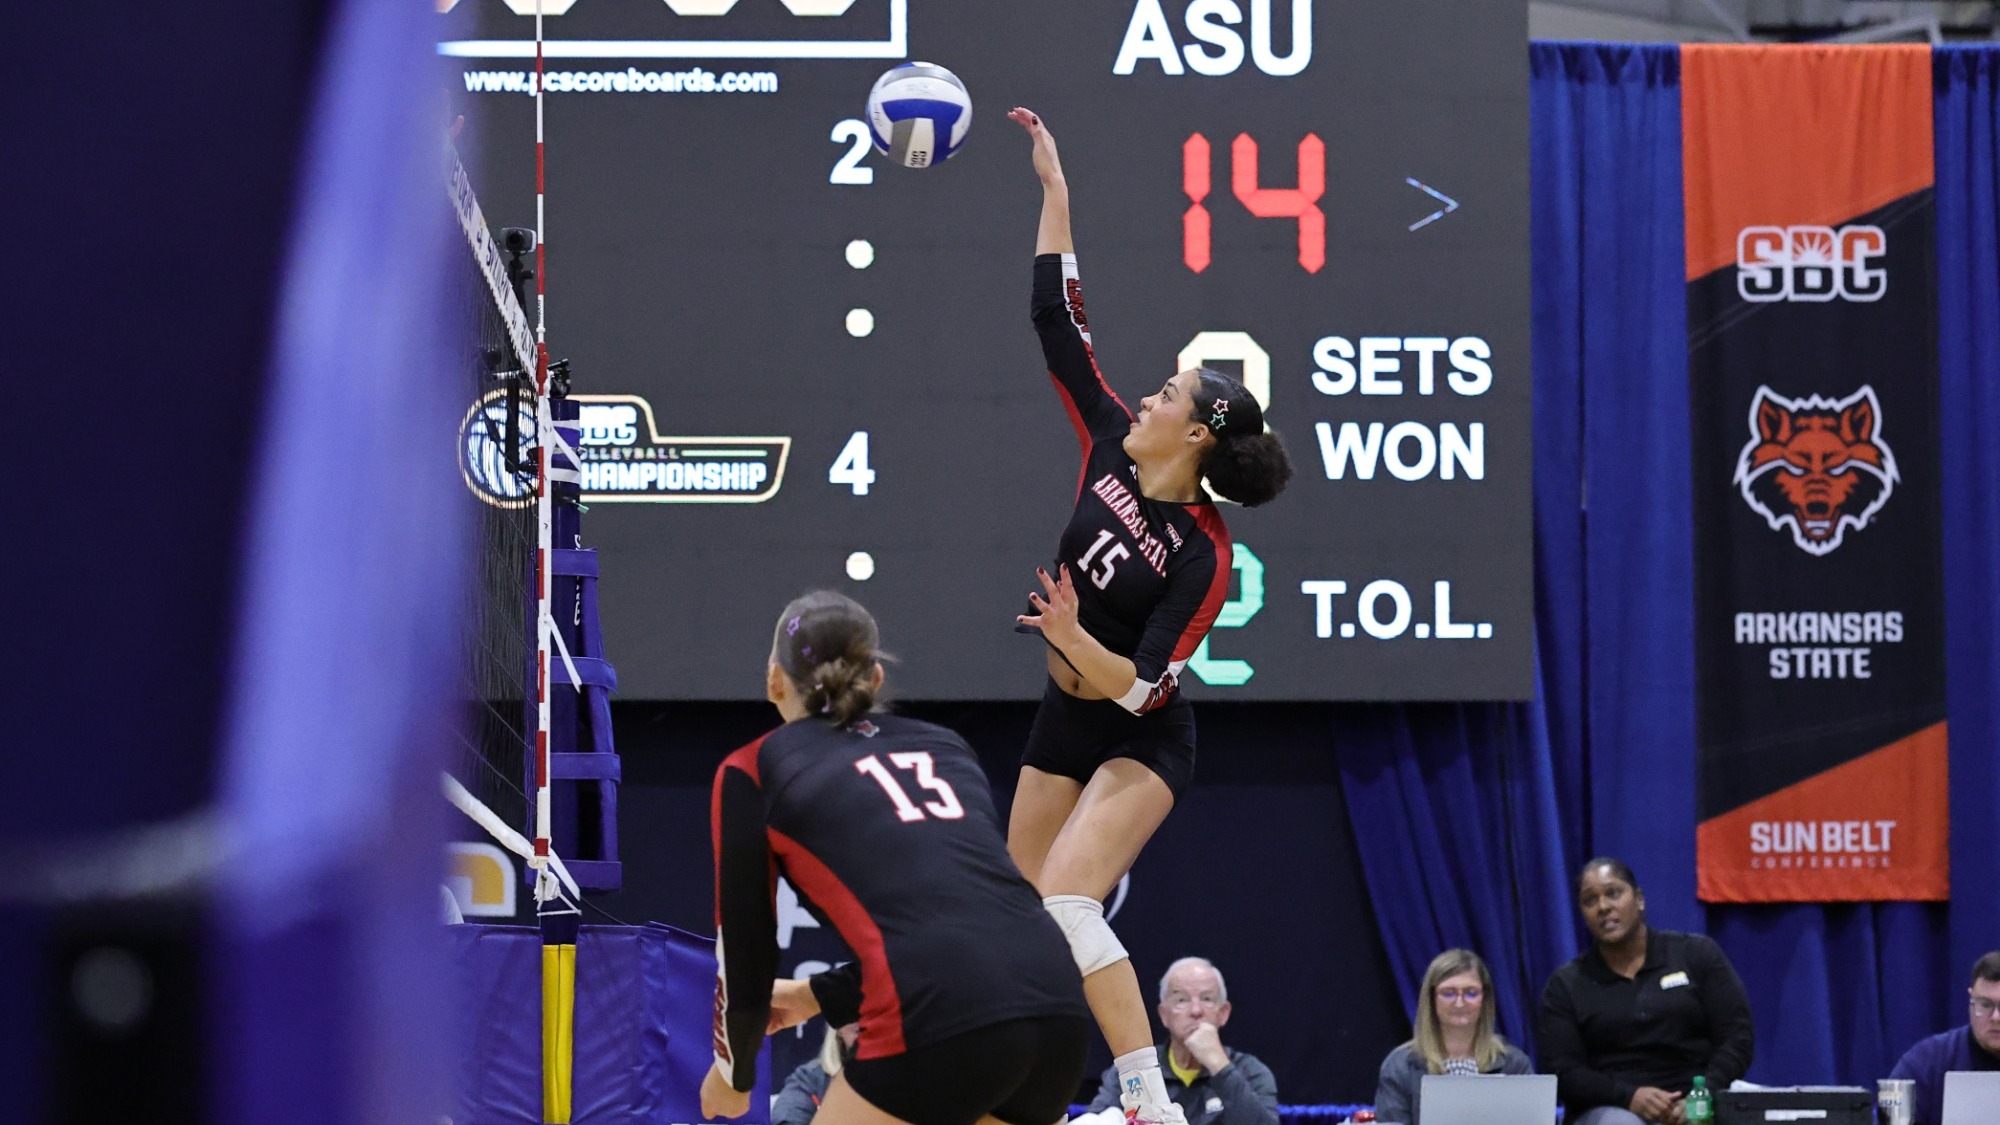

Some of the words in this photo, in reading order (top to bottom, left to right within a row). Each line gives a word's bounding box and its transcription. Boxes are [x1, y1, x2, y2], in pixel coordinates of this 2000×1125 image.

[1113, 0, 1312, 76] ASU
[463, 67, 778, 96] www.pcscoreboards.com
[829, 119, 873, 184] 2
[1183, 132, 1325, 274] 14
[1737, 225, 1887, 302] SBC
[1312, 337, 1493, 395] SETS
[829, 431, 875, 495] 4
[1316, 422, 1484, 481] WON
[1090, 472, 1148, 539] ARKANSAS
[1077, 528, 1131, 590] 15
[1301, 579, 1493, 639] T.O.L.
[1735, 611, 1904, 644] ARKANSAS
[1769, 647, 1872, 679] STATE
[854, 751, 965, 822] 13
[1751, 821, 1817, 853] SUN
[1821, 820, 1896, 853] BELT
